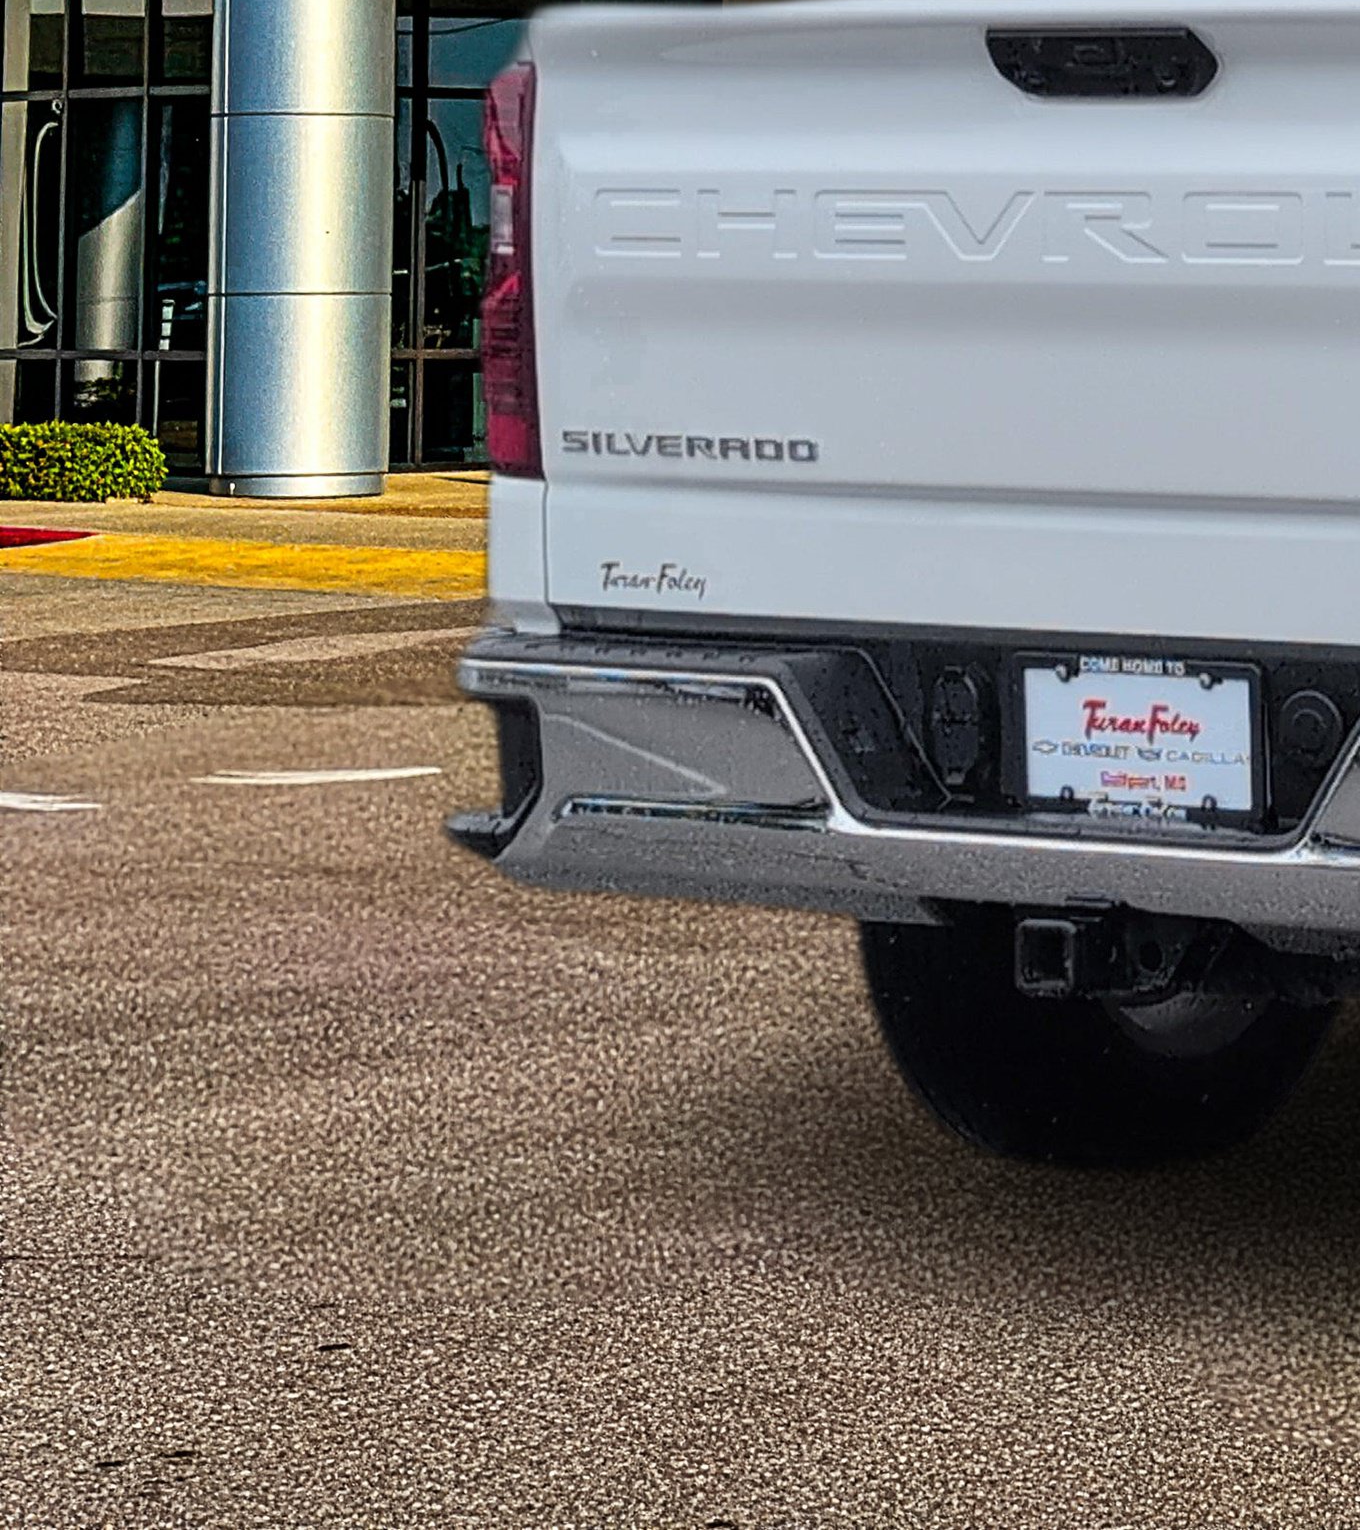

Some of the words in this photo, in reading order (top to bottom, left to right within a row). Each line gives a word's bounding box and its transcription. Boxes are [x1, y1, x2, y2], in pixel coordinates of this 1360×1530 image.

[562, 430, 819, 463] SILVERADO
[1164, 660, 1187, 676] TO
[1147, 703, 1201, 744] Foley
[1166, 749, 1249, 766] CADILLA
